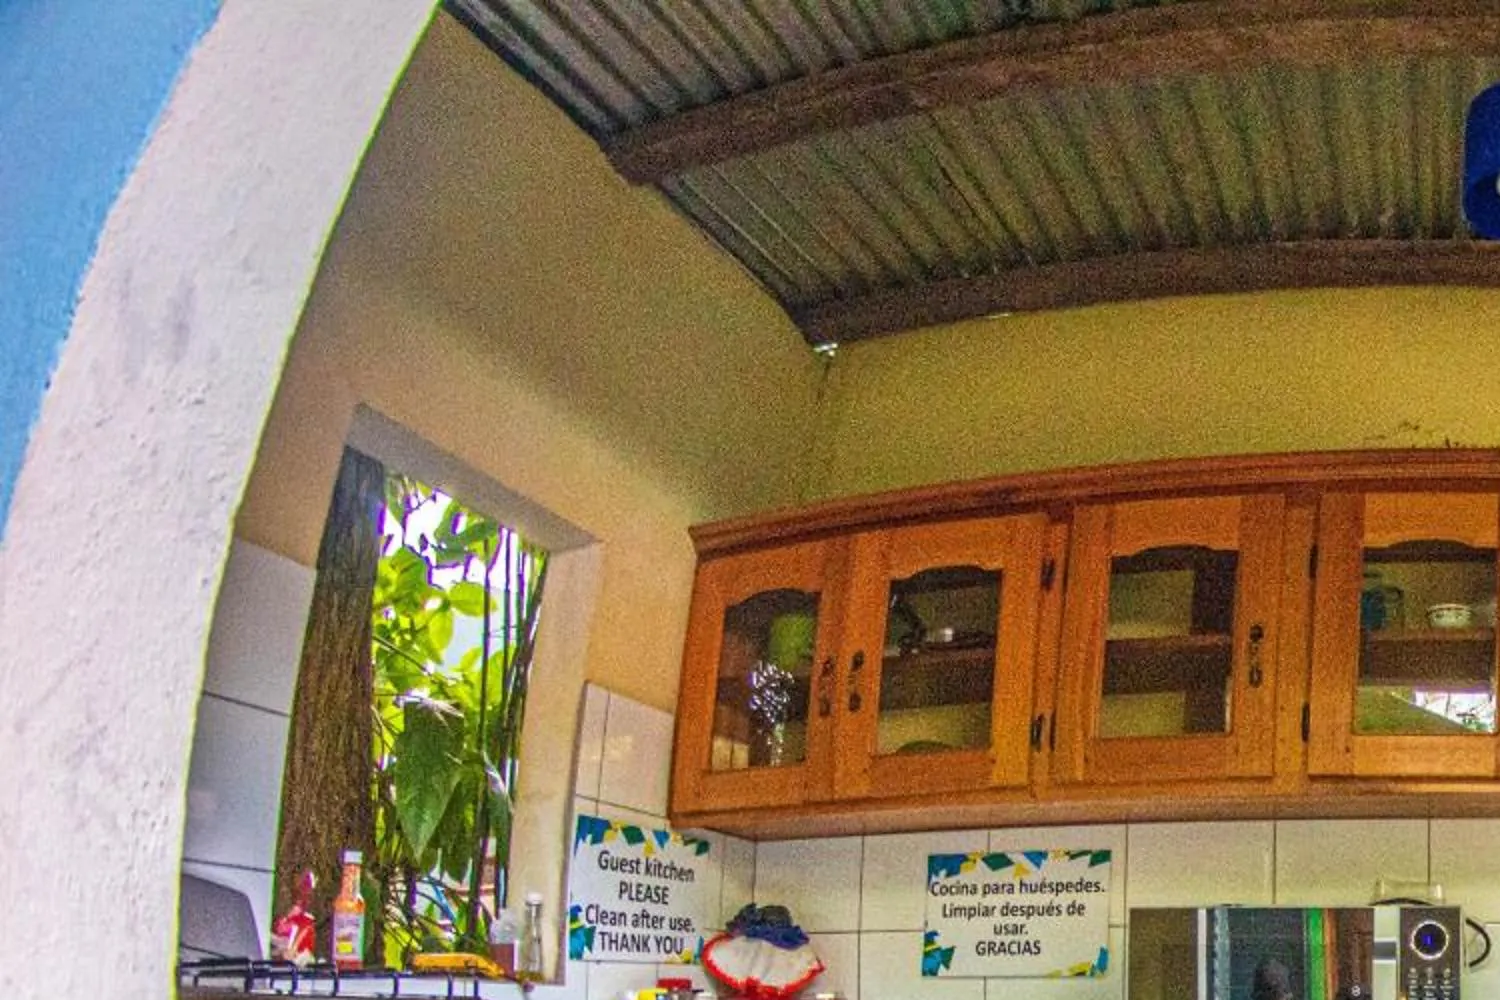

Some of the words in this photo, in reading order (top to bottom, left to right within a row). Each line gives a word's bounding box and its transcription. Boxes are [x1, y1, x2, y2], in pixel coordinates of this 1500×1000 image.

[597, 850, 641, 877] Guest
[644, 856, 695, 882] kitchen
[619, 881, 669, 905] PLEASE
[930, 880, 979, 897] Cocina
[981, 883, 1016, 898] para
[1018, 876, 1106, 897] huéspedes.
[585, 904, 628, 926] Clean
[630, 908, 666, 930] after
[668, 917, 696, 933] use.
[941, 902, 997, 921] Limpiar
[999, 900, 1063, 921] después
[1066, 900, 1087, 917] de
[992, 923, 1030, 936] usar.
[599, 931, 652, 952] THANK
[653, 934, 685, 956] YOU
[974, 939, 1042, 957] GRACIAS
